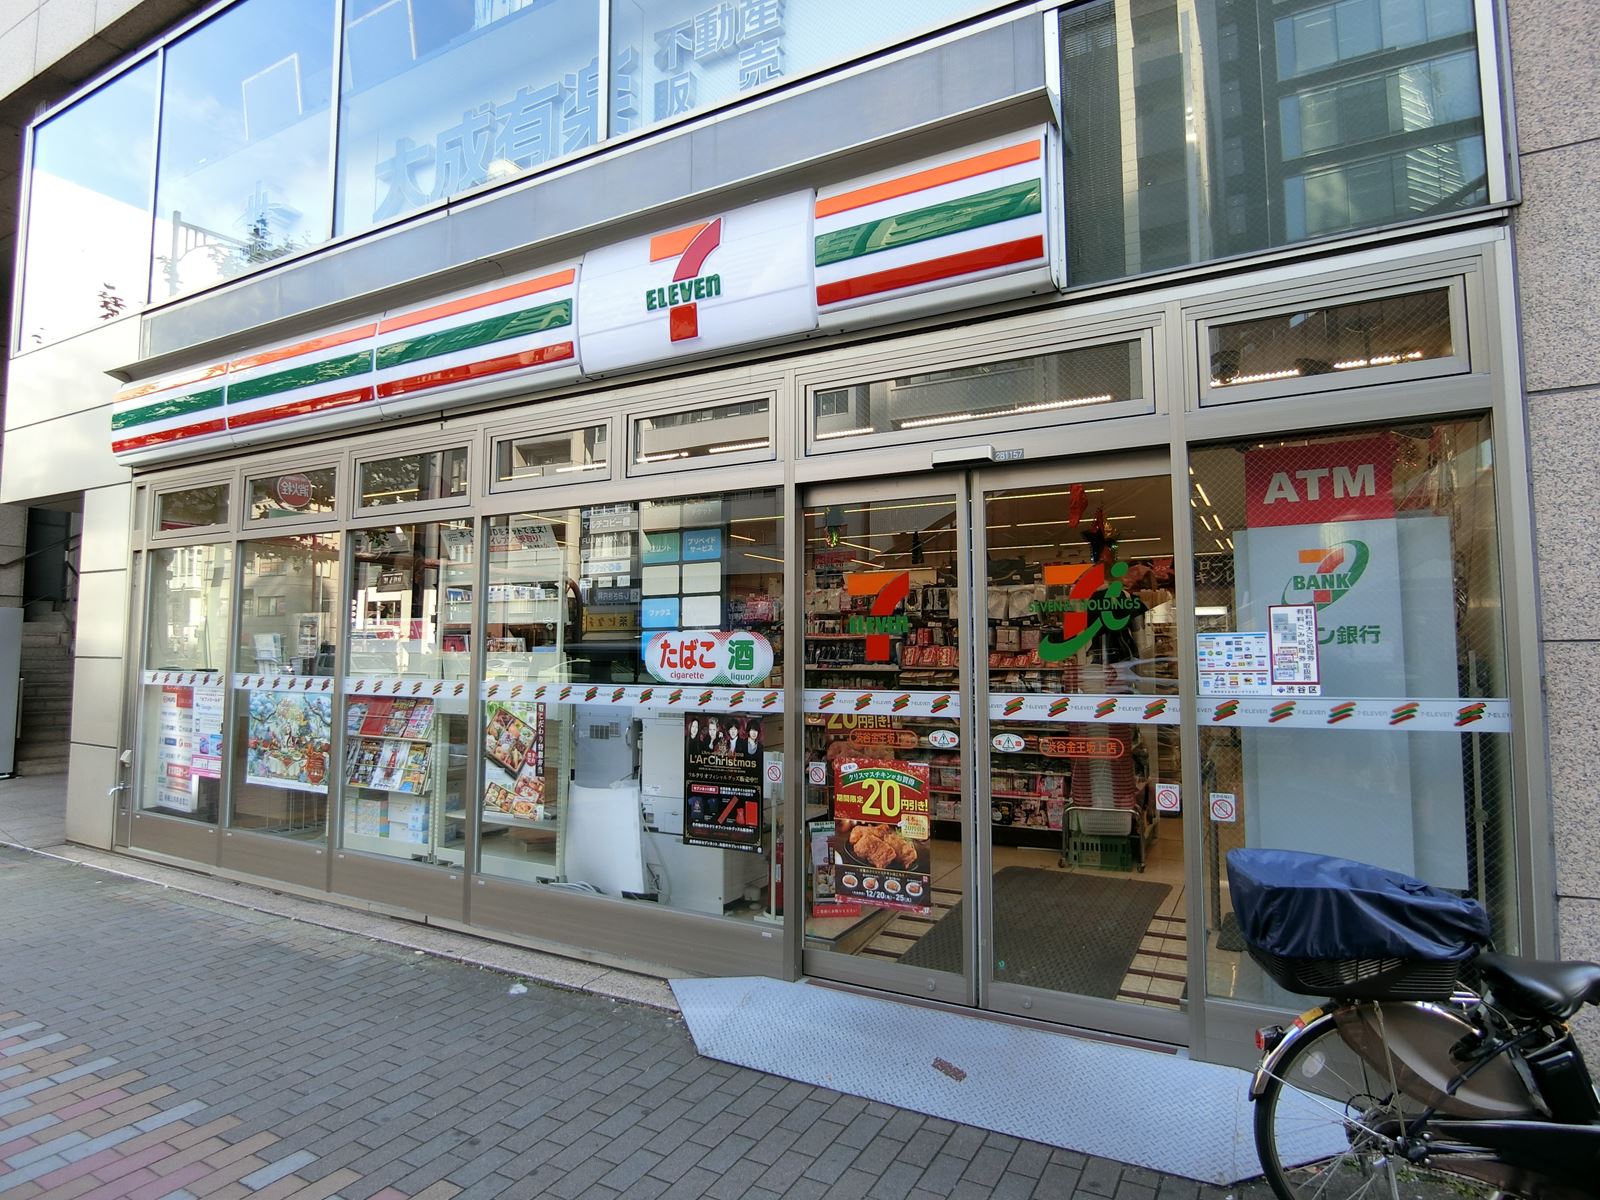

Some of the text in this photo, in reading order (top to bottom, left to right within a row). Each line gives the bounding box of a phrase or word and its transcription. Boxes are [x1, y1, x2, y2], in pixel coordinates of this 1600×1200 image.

[655, 0, 784, 72] 不動産
[373, 45, 639, 223] 大成有楽
[650, 217, 721, 342] 7
[995, 449, 1023, 461] 281157
[1263, 463, 1376, 504] ATM
[583, 517, 631, 530] マルチコピー
[690, 544, 714, 553] サービス
[1293, 573, 1350, 590] BANK
[660, 638, 754, 671] たばこ 酒
[670, 671, 755, 681] cigarette liquor
[1286, 686, 1317, 694] 渋谷区
[1047, 741, 1117, 754] 渋谷金王坂上店
[836, 778, 928, 817] 期間限定 20 円引き!
